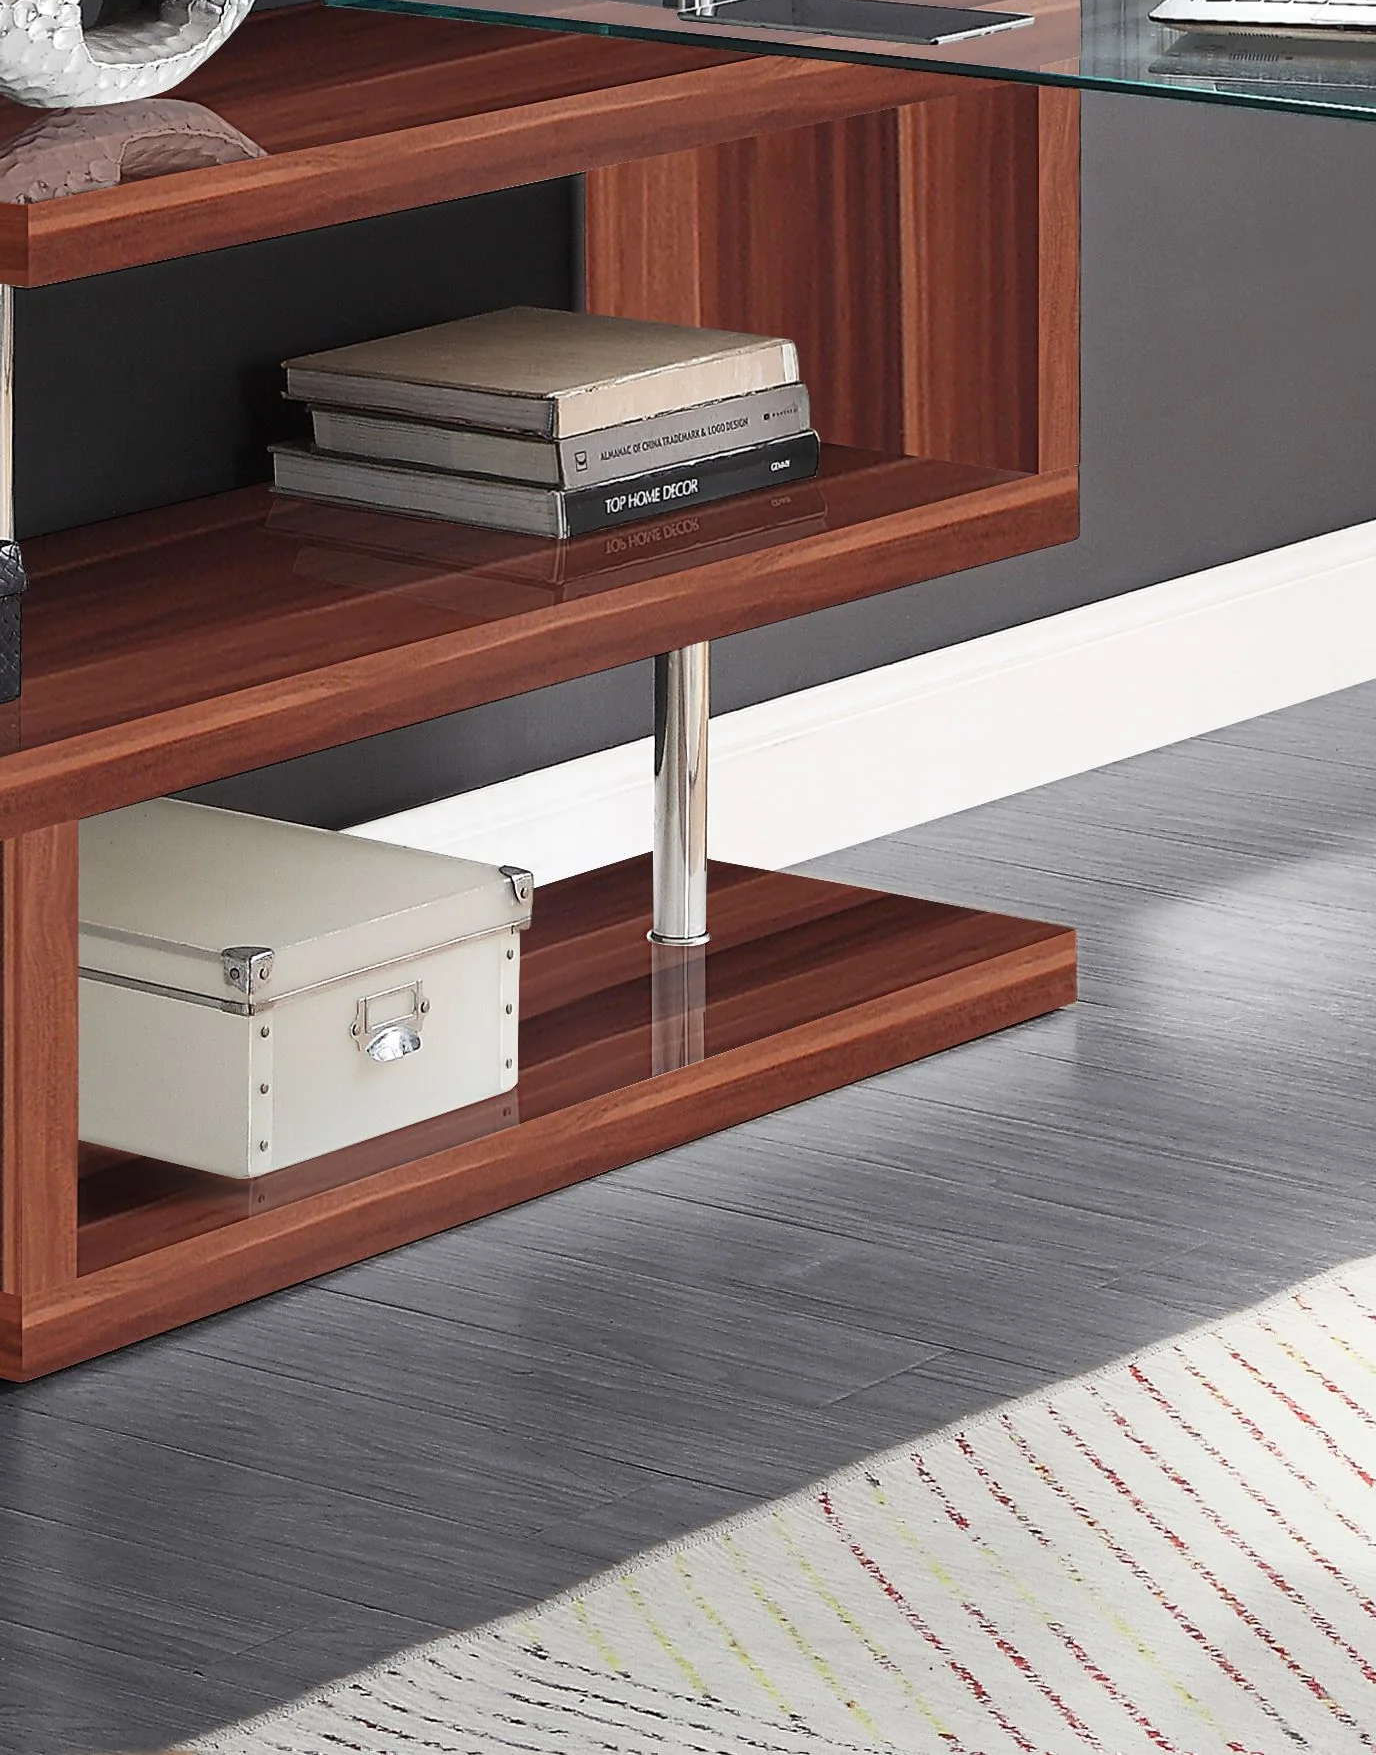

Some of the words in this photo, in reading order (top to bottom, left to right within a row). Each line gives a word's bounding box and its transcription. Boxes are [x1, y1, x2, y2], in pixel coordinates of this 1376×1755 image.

[632, 441, 641, 453] OF
[641, 438, 663, 452] CHINA
[662, 428, 701, 446] TRADEMARK
[700, 427, 706, 437] &
[708, 423, 726, 436] LOGO
[725, 417, 749, 432] DESIGN
[604, 495, 626, 514] TOP
[628, 487, 661, 509] HOME
[662, 479, 699, 501] DECOR
